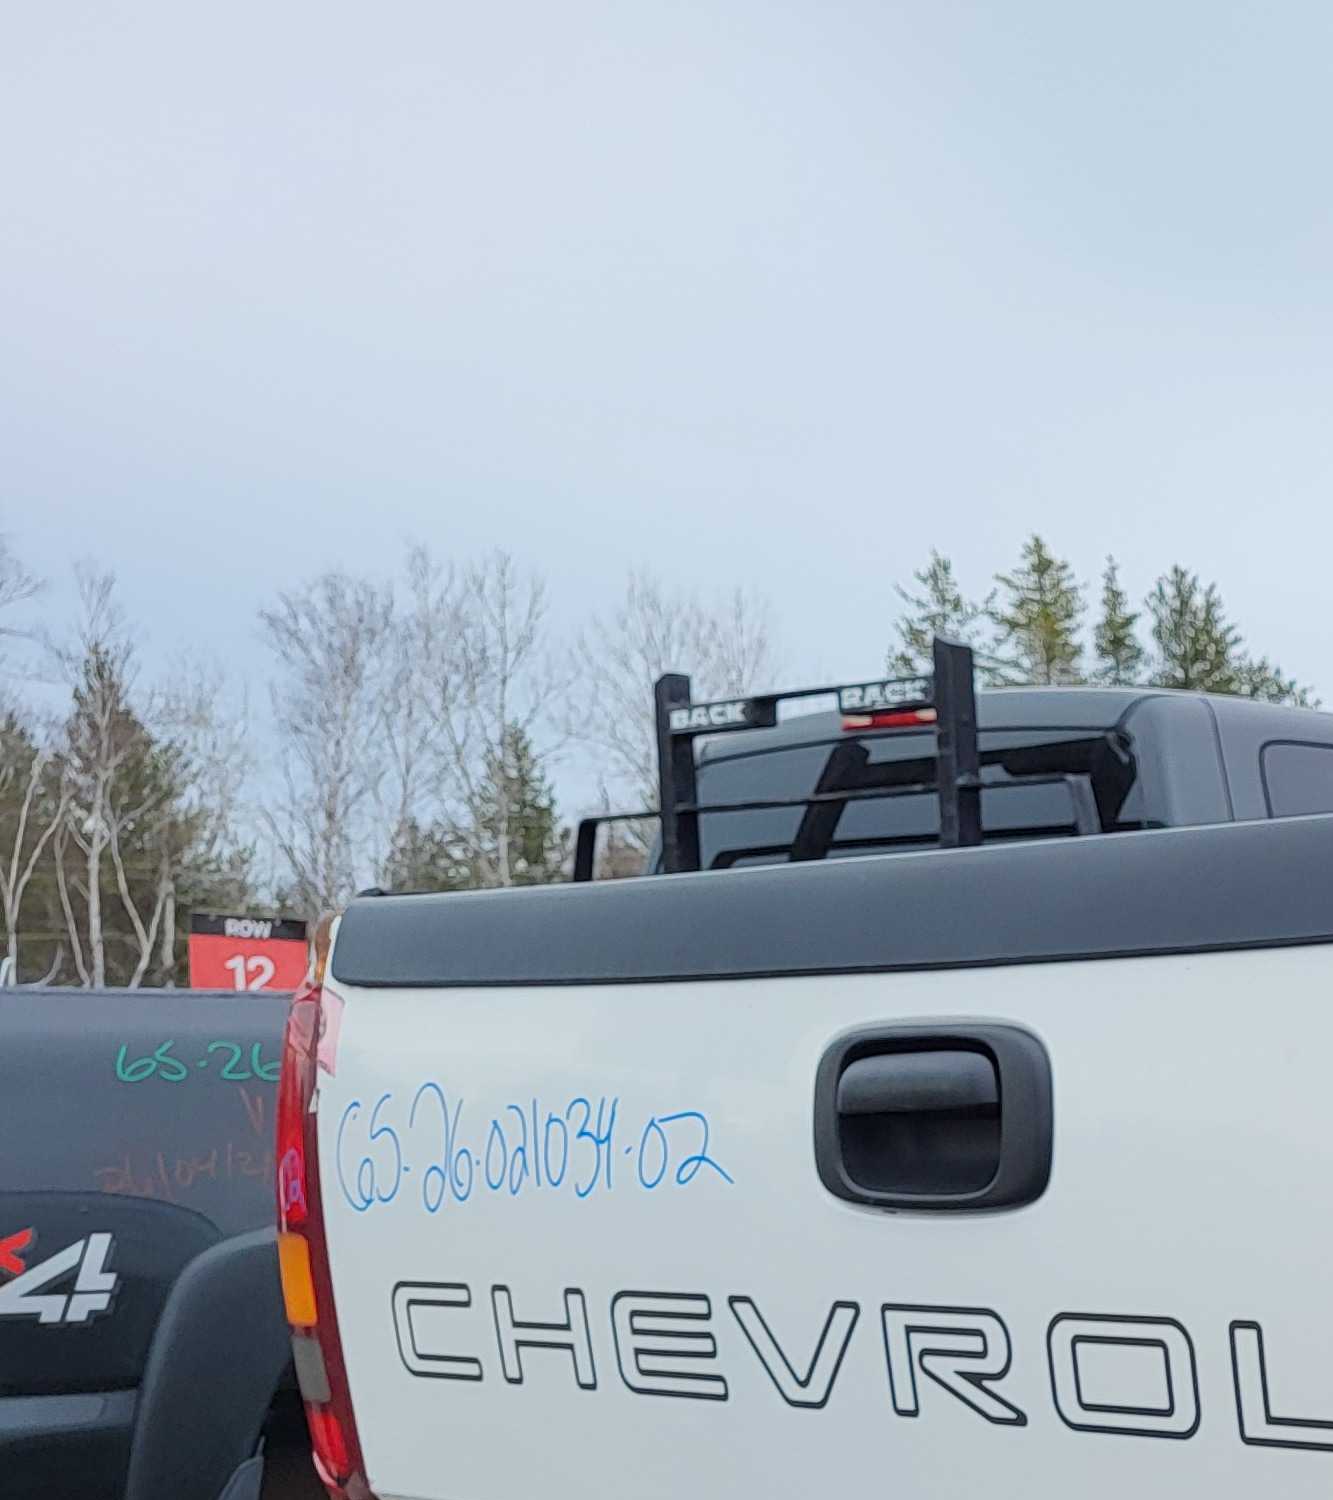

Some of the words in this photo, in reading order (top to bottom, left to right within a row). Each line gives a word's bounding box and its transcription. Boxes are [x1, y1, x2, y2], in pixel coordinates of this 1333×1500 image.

[840, 679, 931, 708] RACK
[223, 918, 273, 939] ROW
[224, 955, 275, 991] 12
